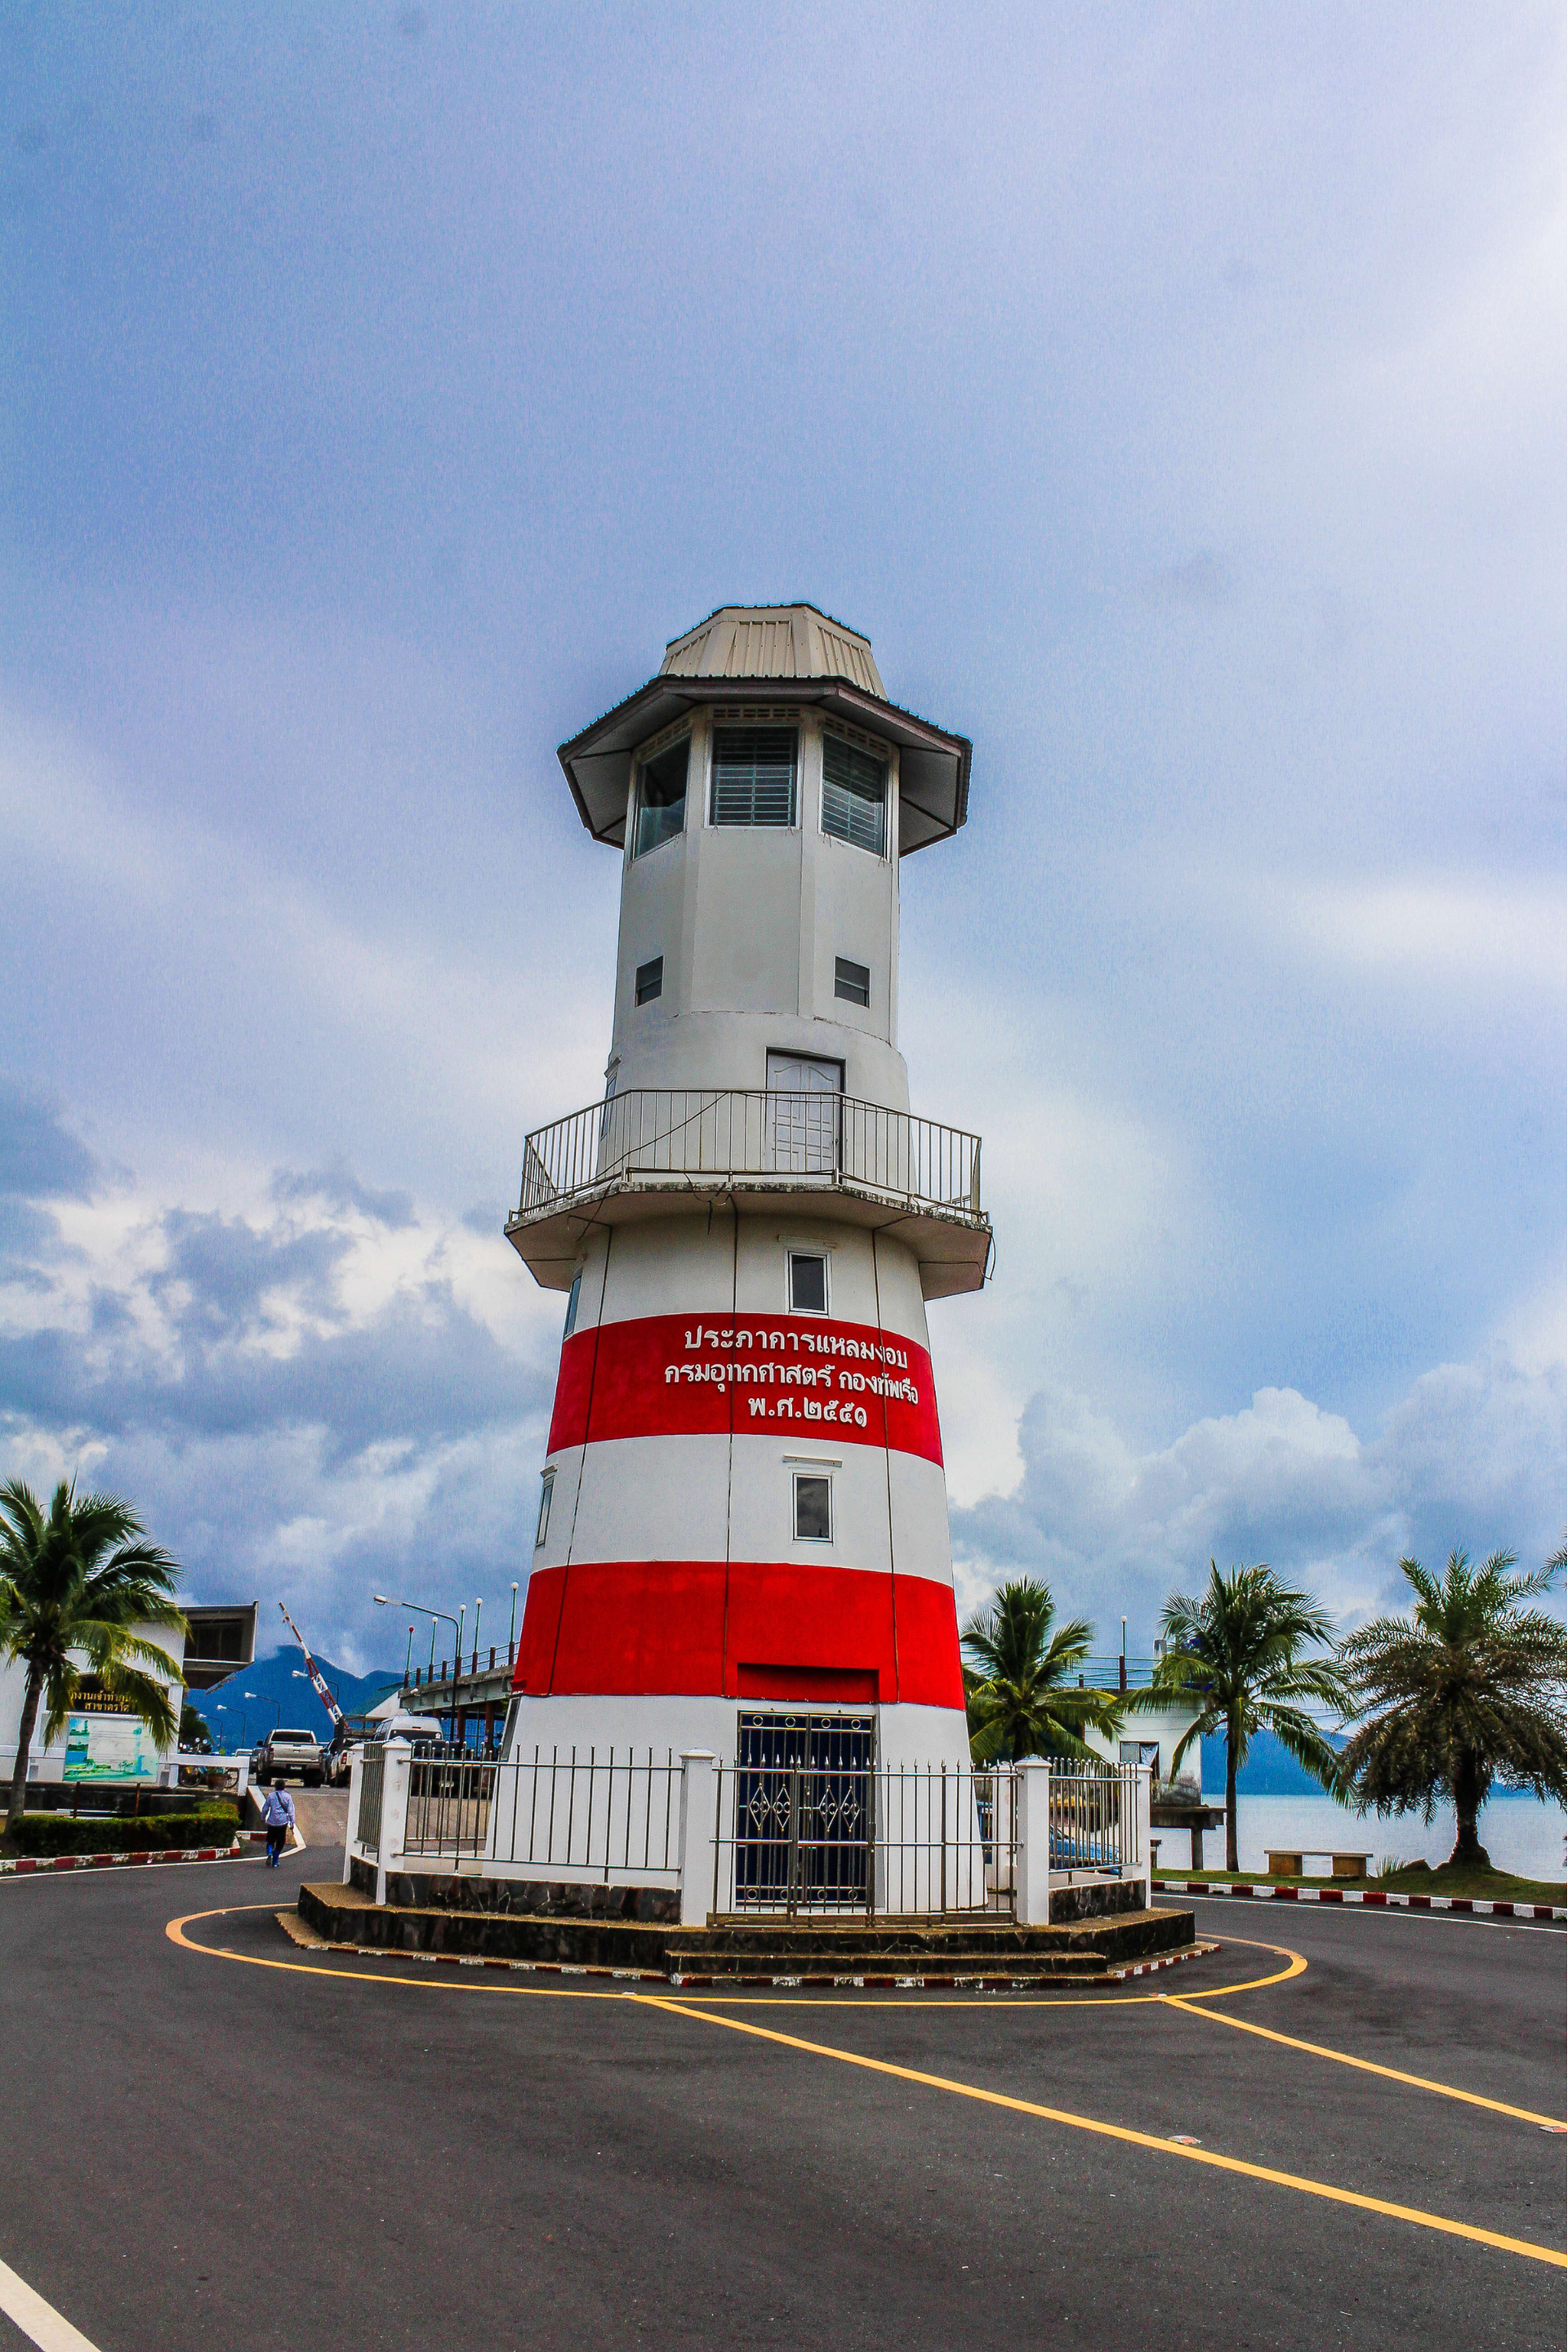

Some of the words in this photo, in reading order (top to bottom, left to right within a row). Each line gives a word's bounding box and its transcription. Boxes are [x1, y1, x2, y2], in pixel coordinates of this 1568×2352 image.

[684, 1325, 908, 1369] ประภาคารแหลมงอบ
[664, 1362, 835, 1392] กรมอุทกศาสตร์
[839, 1371, 919, 1405] กองทัพเรือ
